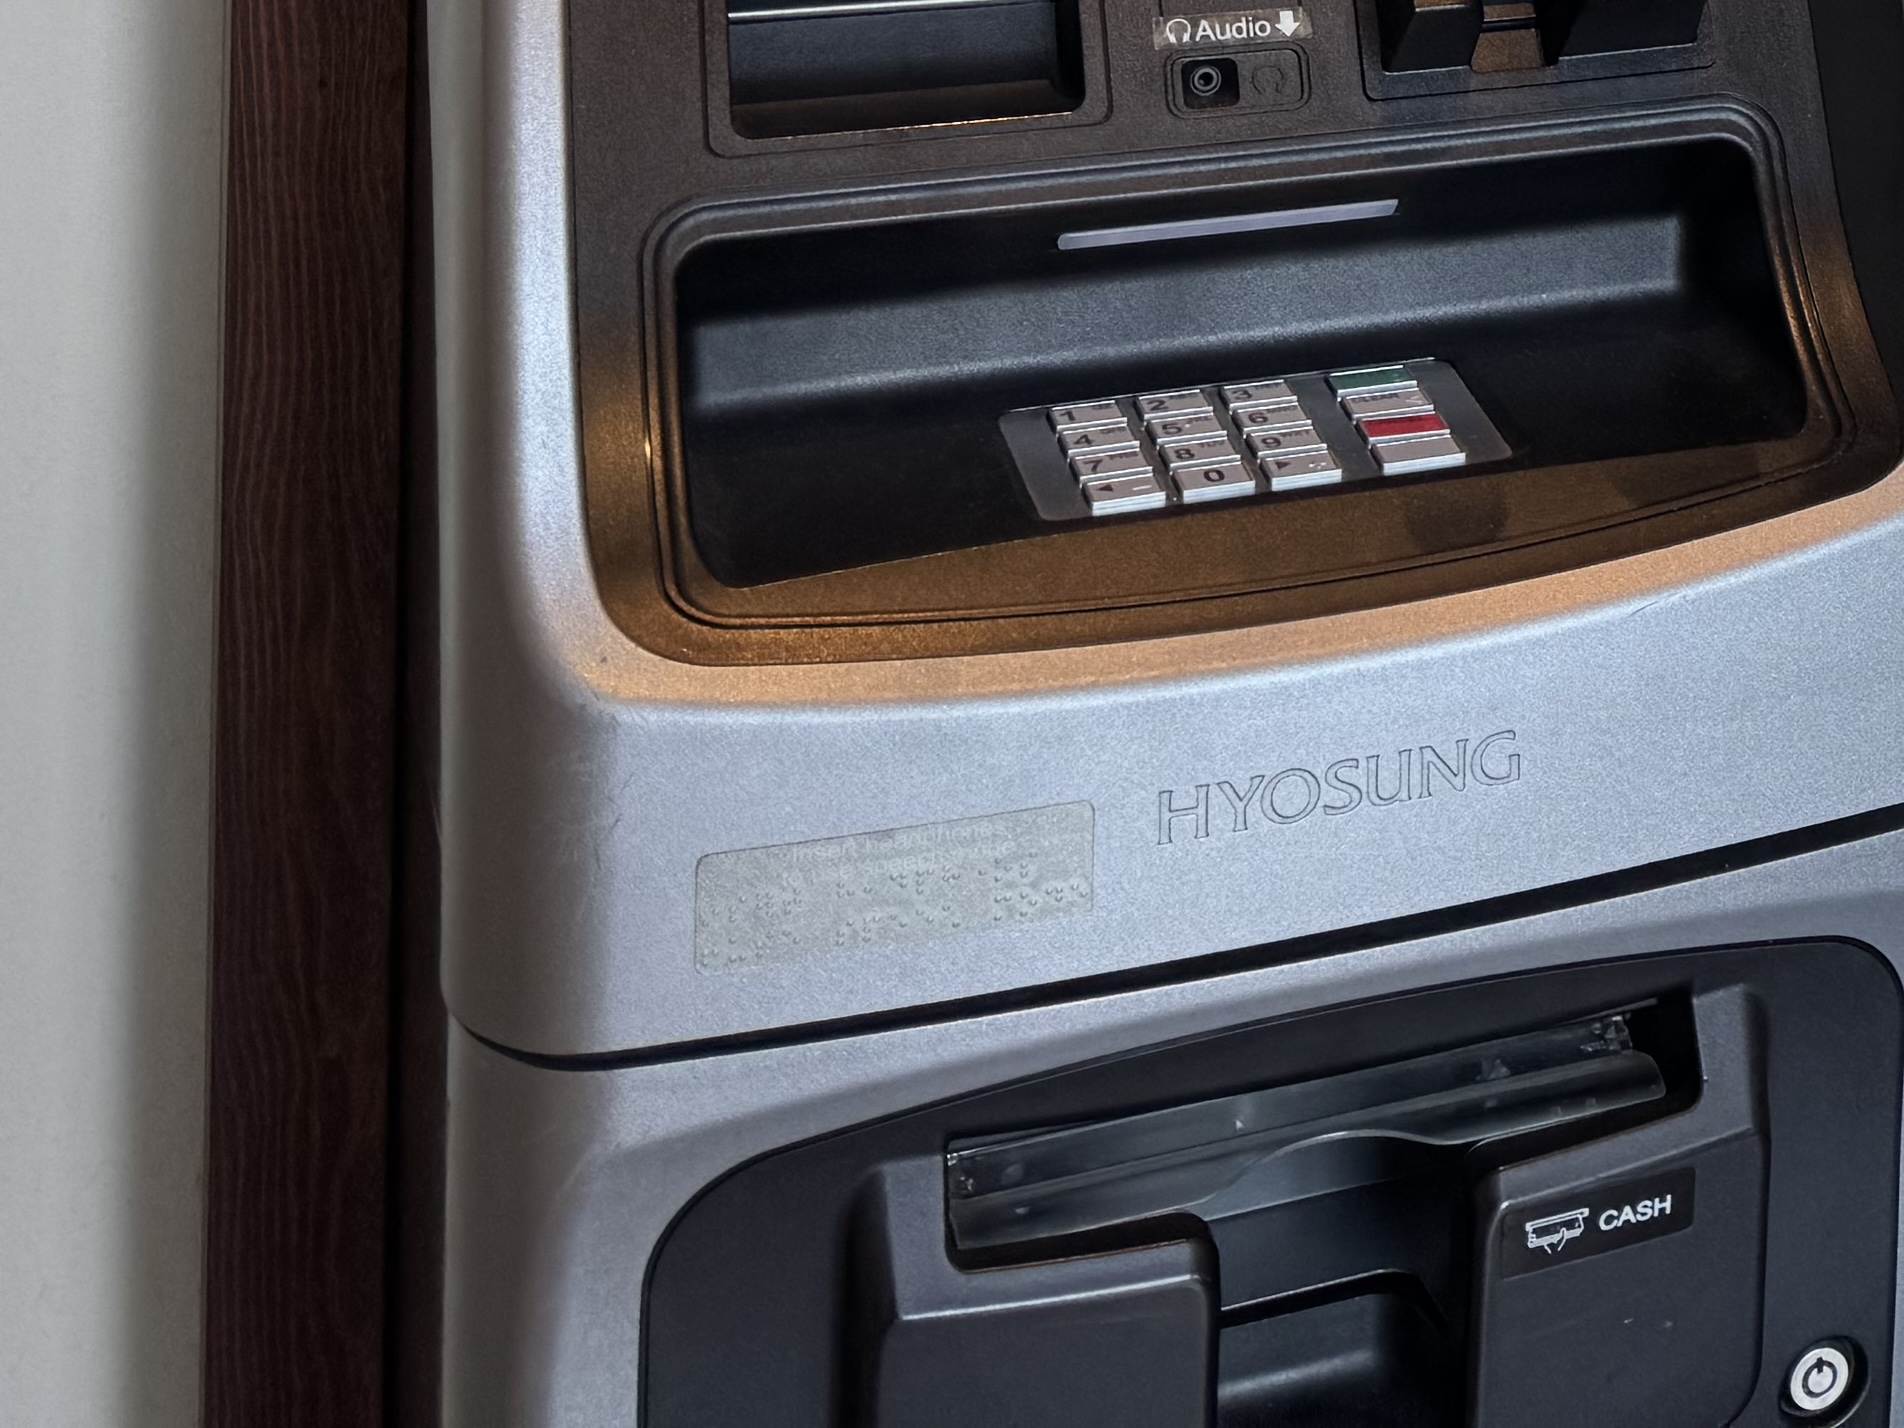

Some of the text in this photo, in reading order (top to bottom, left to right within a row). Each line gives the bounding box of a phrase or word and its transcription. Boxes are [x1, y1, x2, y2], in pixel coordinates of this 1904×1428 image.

[1195, 16, 1271, 42] Audio
[1231, 389, 1253, 400] 3
[1146, 399, 1169, 411] 2
[1059, 410, 1076, 422] 1
[1247, 411, 1269, 425] 6
[1161, 422, 1184, 435] 5
[1073, 433, 1095, 445] 4
[1260, 436, 1282, 449] 9
[1173, 447, 1196, 460] 8
[1082, 458, 1103, 473] 7
[1203, 468, 1226, 483] 0
[1156, 729, 1522, 845] HYOSUNG
[1598, 1194, 1672, 1231] CASH
